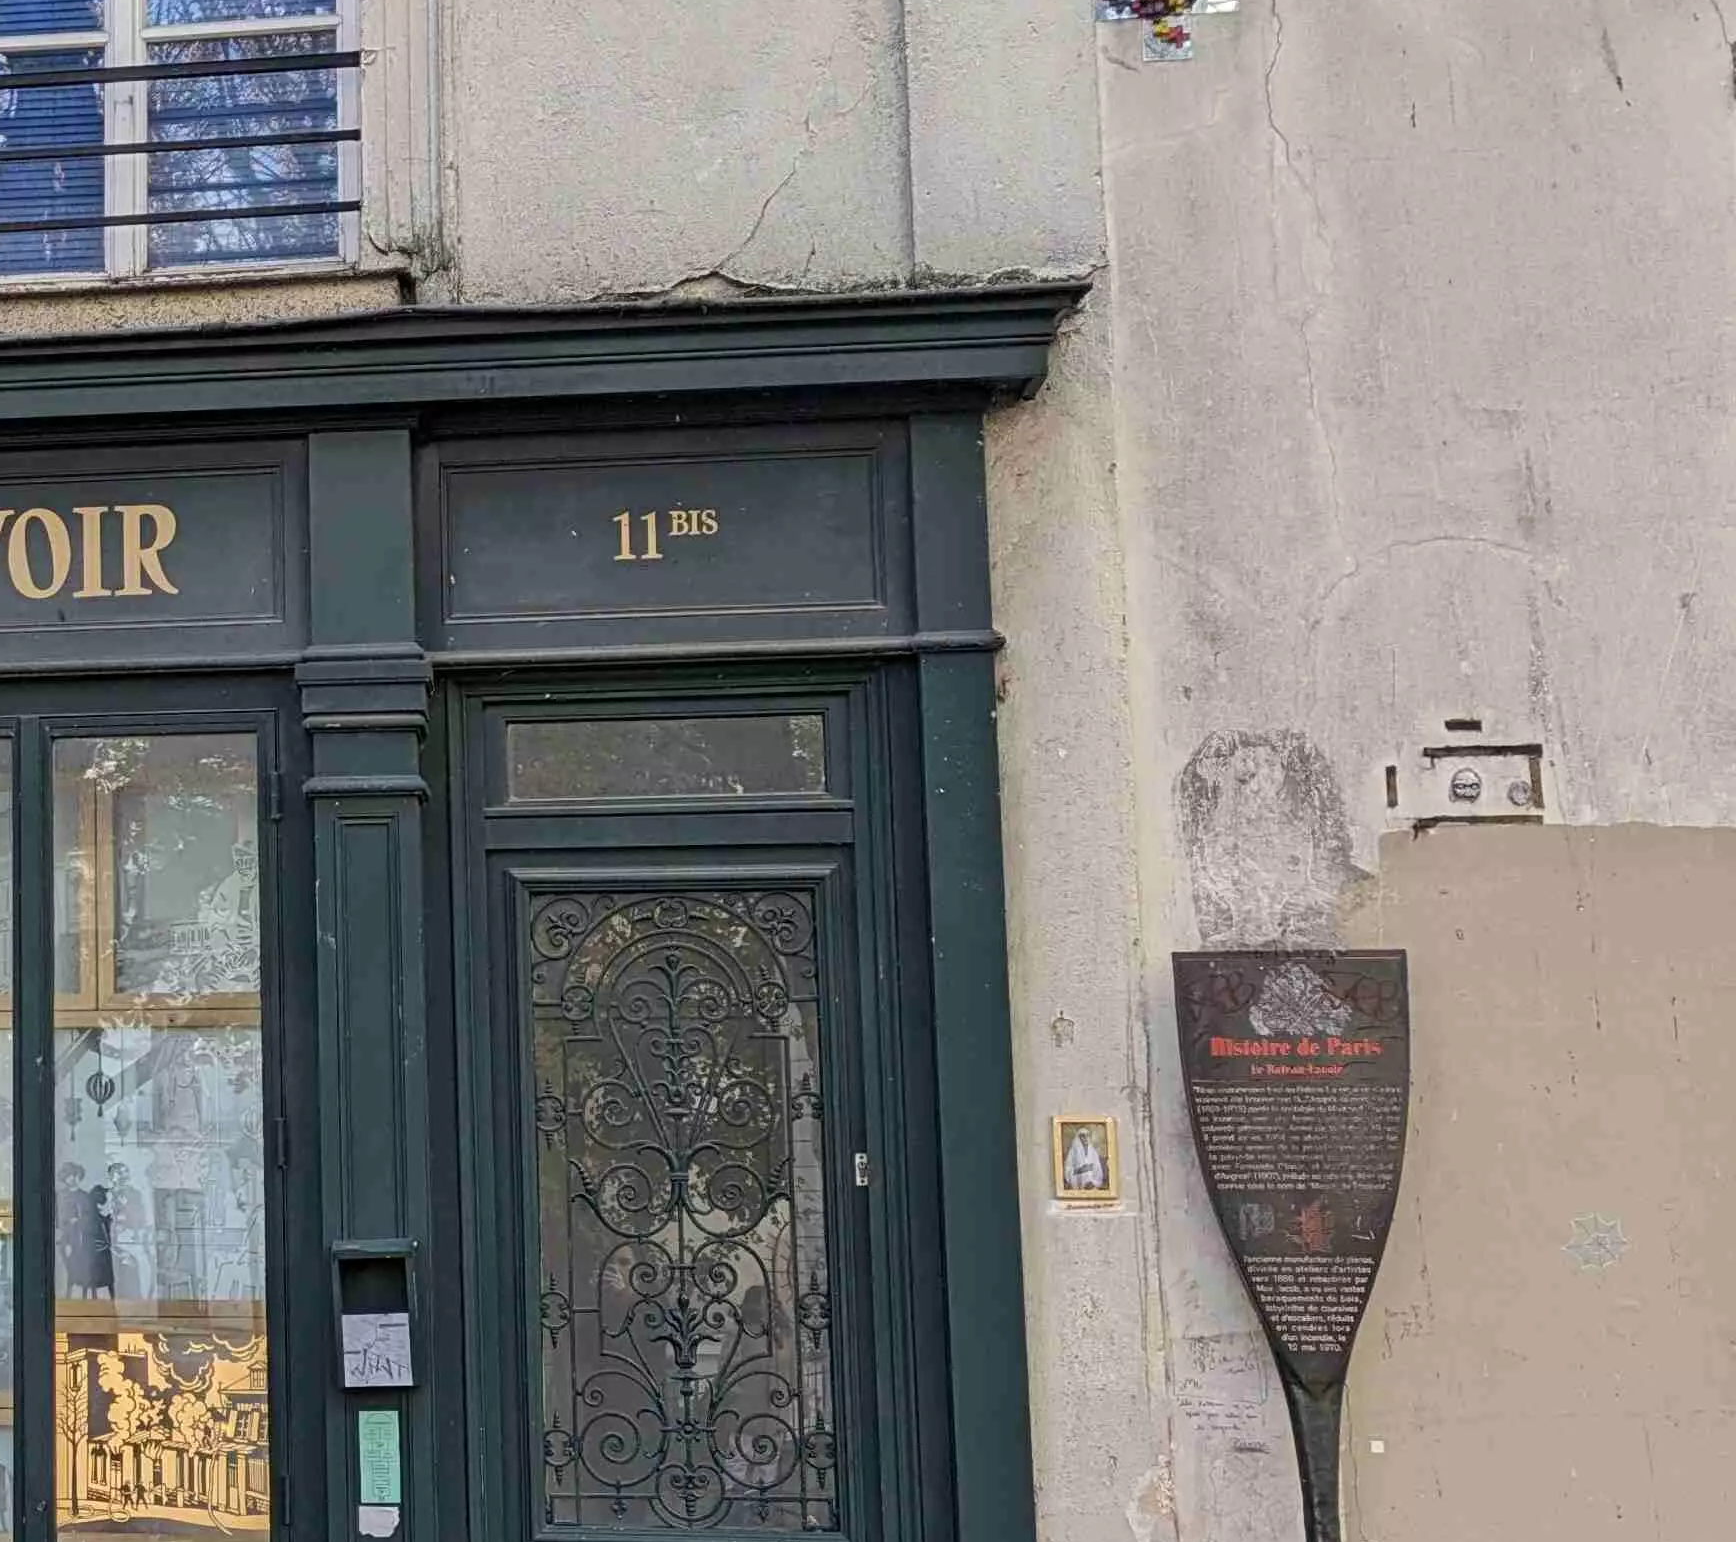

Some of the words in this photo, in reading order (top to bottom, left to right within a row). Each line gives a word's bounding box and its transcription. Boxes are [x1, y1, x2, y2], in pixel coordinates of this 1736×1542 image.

[612, 510, 664, 561] 11
[667, 508, 719, 536] BIS
[1209, 1035, 1291, 1058] Histoire
[1296, 1036, 1320, 1059] de
[1325, 1035, 1383, 1058] Paris
